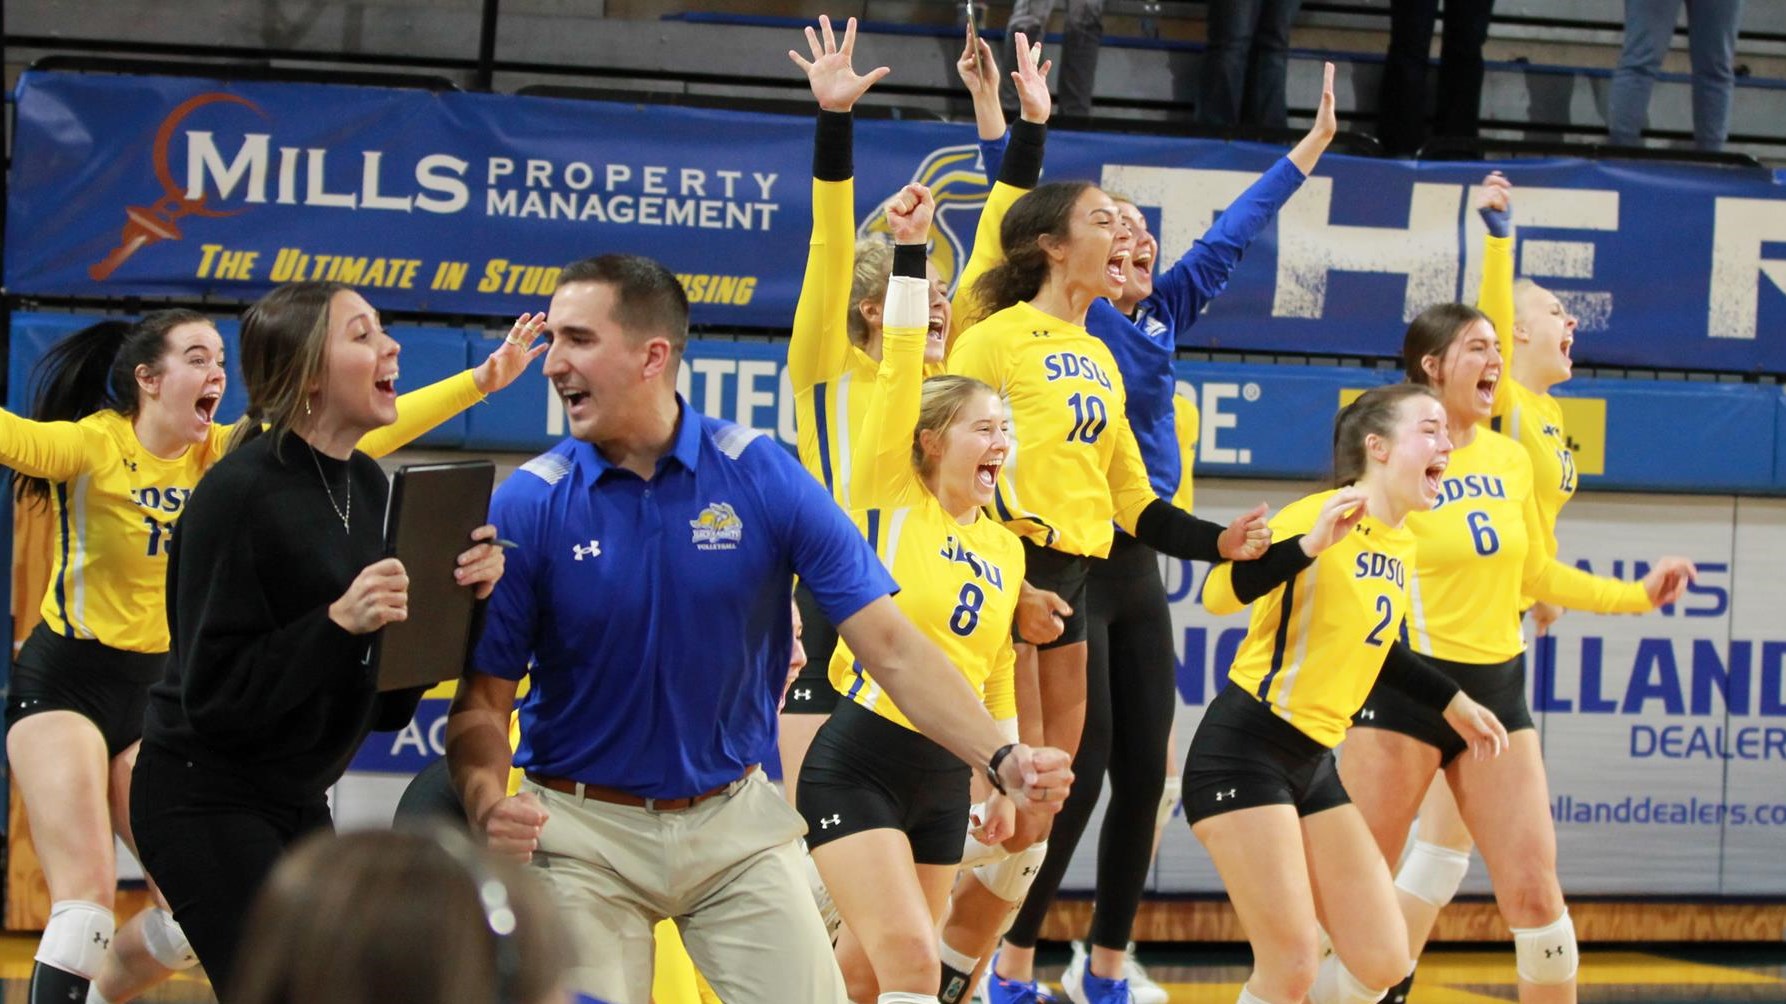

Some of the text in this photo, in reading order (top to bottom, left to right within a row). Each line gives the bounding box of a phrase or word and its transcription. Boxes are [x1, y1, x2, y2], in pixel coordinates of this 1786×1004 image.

[185, 130, 469, 214] MILLS
[487, 157, 778, 200] PROPERTY
[486, 188, 779, 231] MANAGEMENT
[1100, 163, 1620, 331] THE
[196, 244, 758, 306] THE ULTIMATE IN STUD SING
[1045, 352, 1112, 392] SDSU
[1067, 392, 1107, 445] 10
[1466, 511, 1500, 557] 6
[1354, 551, 1405, 591] SDSU
[949, 582, 984, 637] 8
[1364, 594, 1393, 648] 2
[1550, 795, 1786, 826] llanddealers.co
